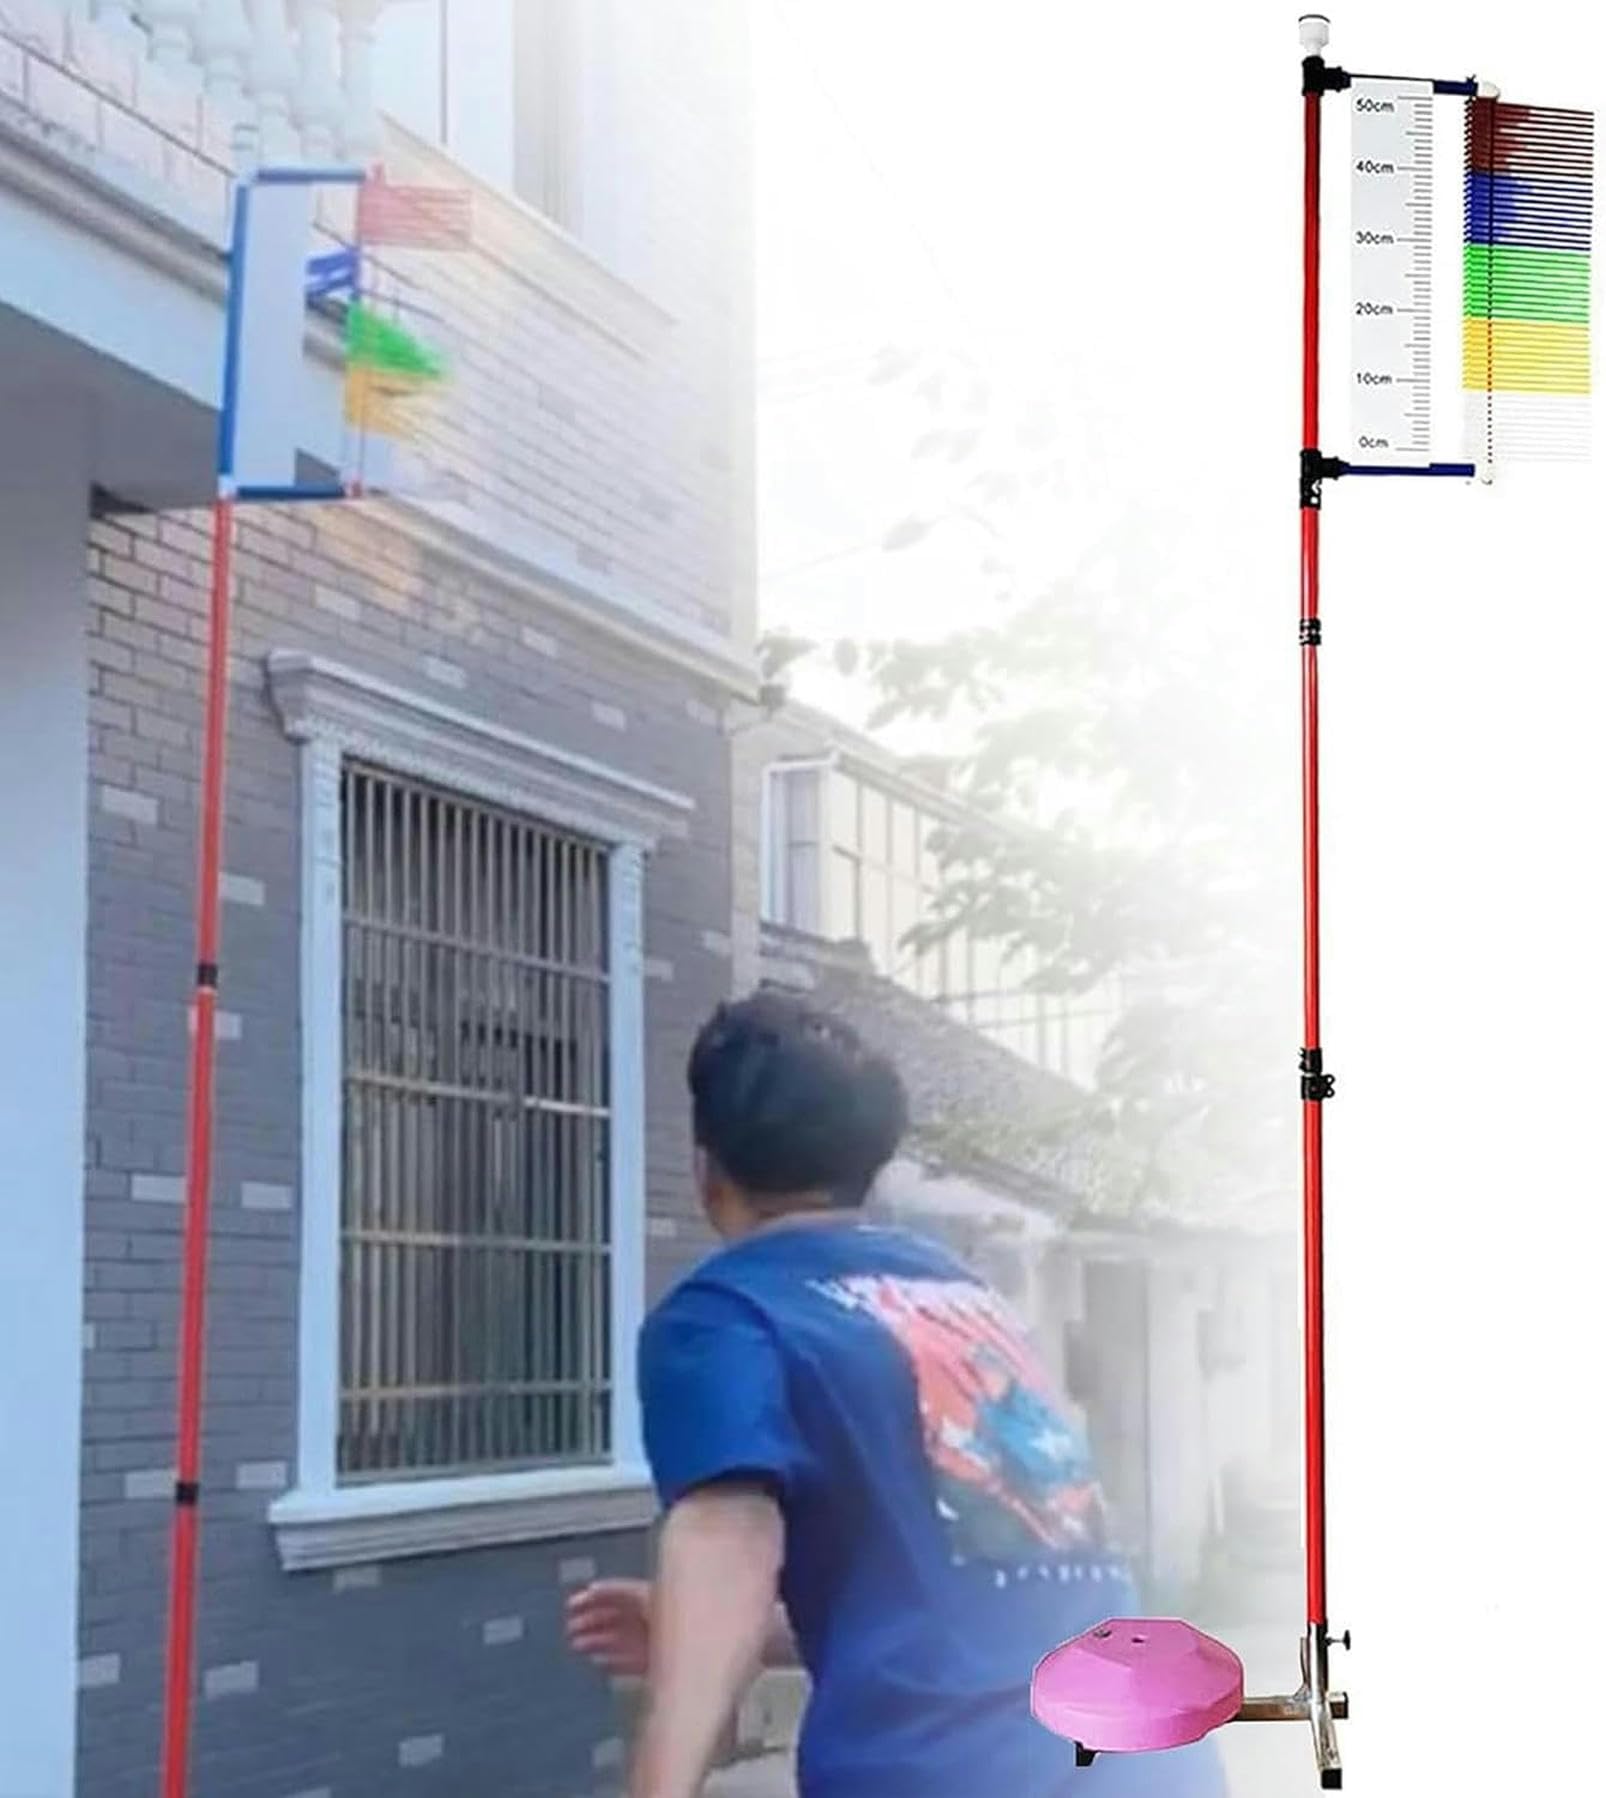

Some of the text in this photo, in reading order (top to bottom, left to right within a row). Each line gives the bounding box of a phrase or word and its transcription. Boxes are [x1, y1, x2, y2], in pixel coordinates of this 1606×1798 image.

[1356, 98, 1394, 112] 50cm
[1356, 160, 1394, 173] 40cm
[1356, 231, 1394, 244] 30cm
[1356, 302, 1393, 315] 20cm
[1356, 372, 1392, 385] 10cm
[1358, 435, 1388, 448] 0cm
